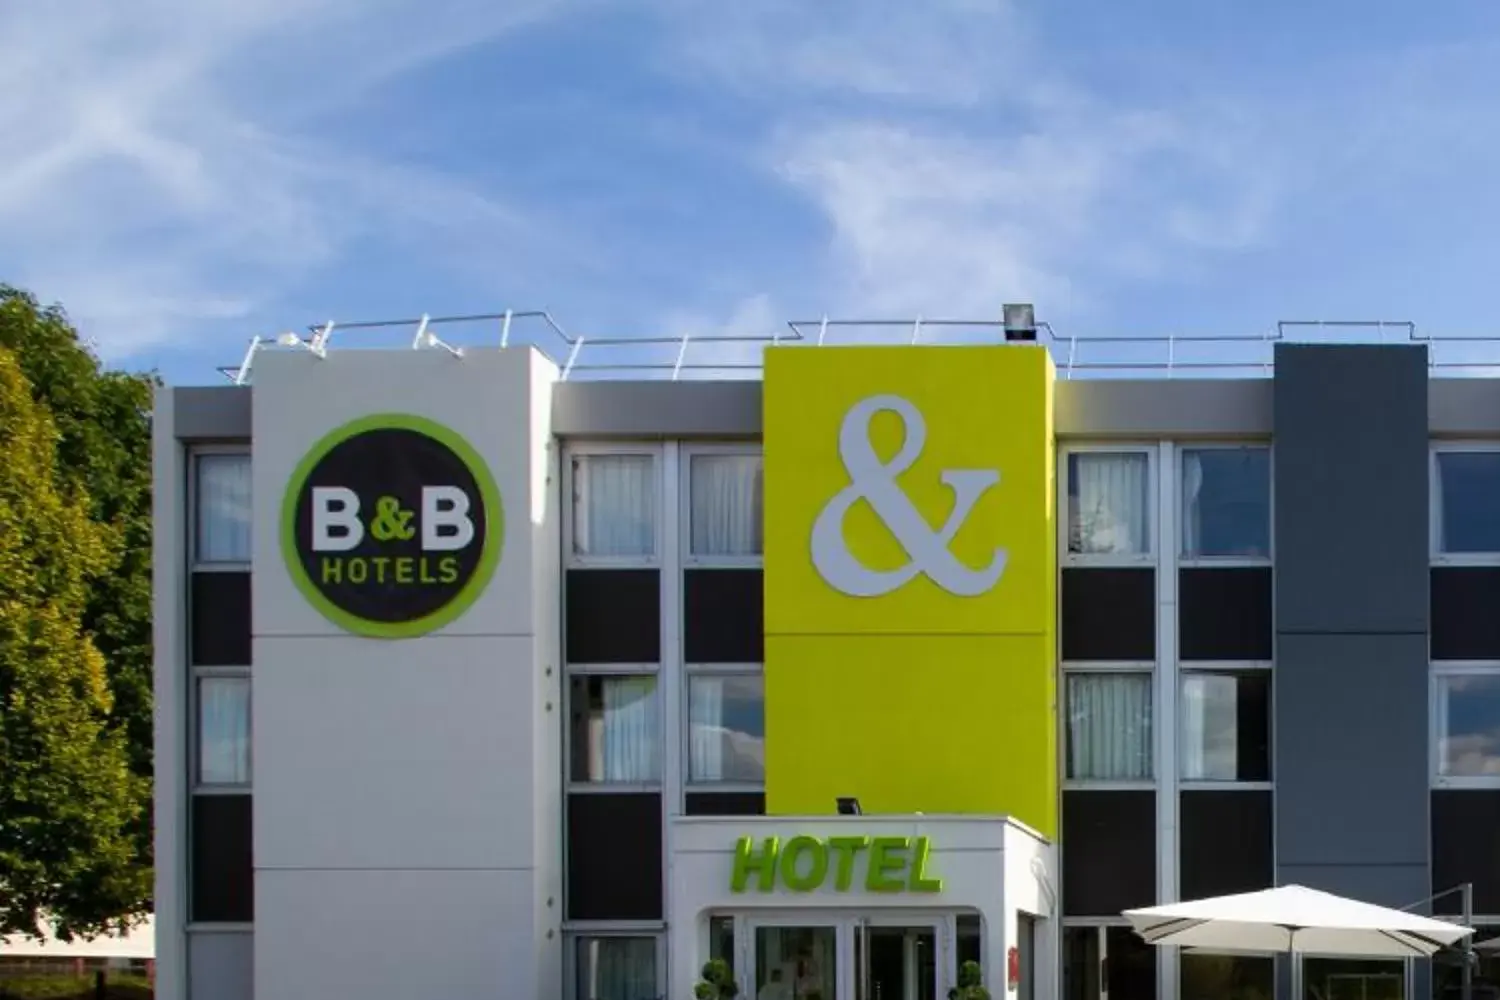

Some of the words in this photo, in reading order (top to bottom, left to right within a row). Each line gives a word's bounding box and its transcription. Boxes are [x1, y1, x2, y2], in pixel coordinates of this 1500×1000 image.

[311, 485, 475, 552] B&B
[810, 393, 1008, 597] &
[321, 557, 460, 584] HOTELS
[729, 834, 944, 894] HOTEL
